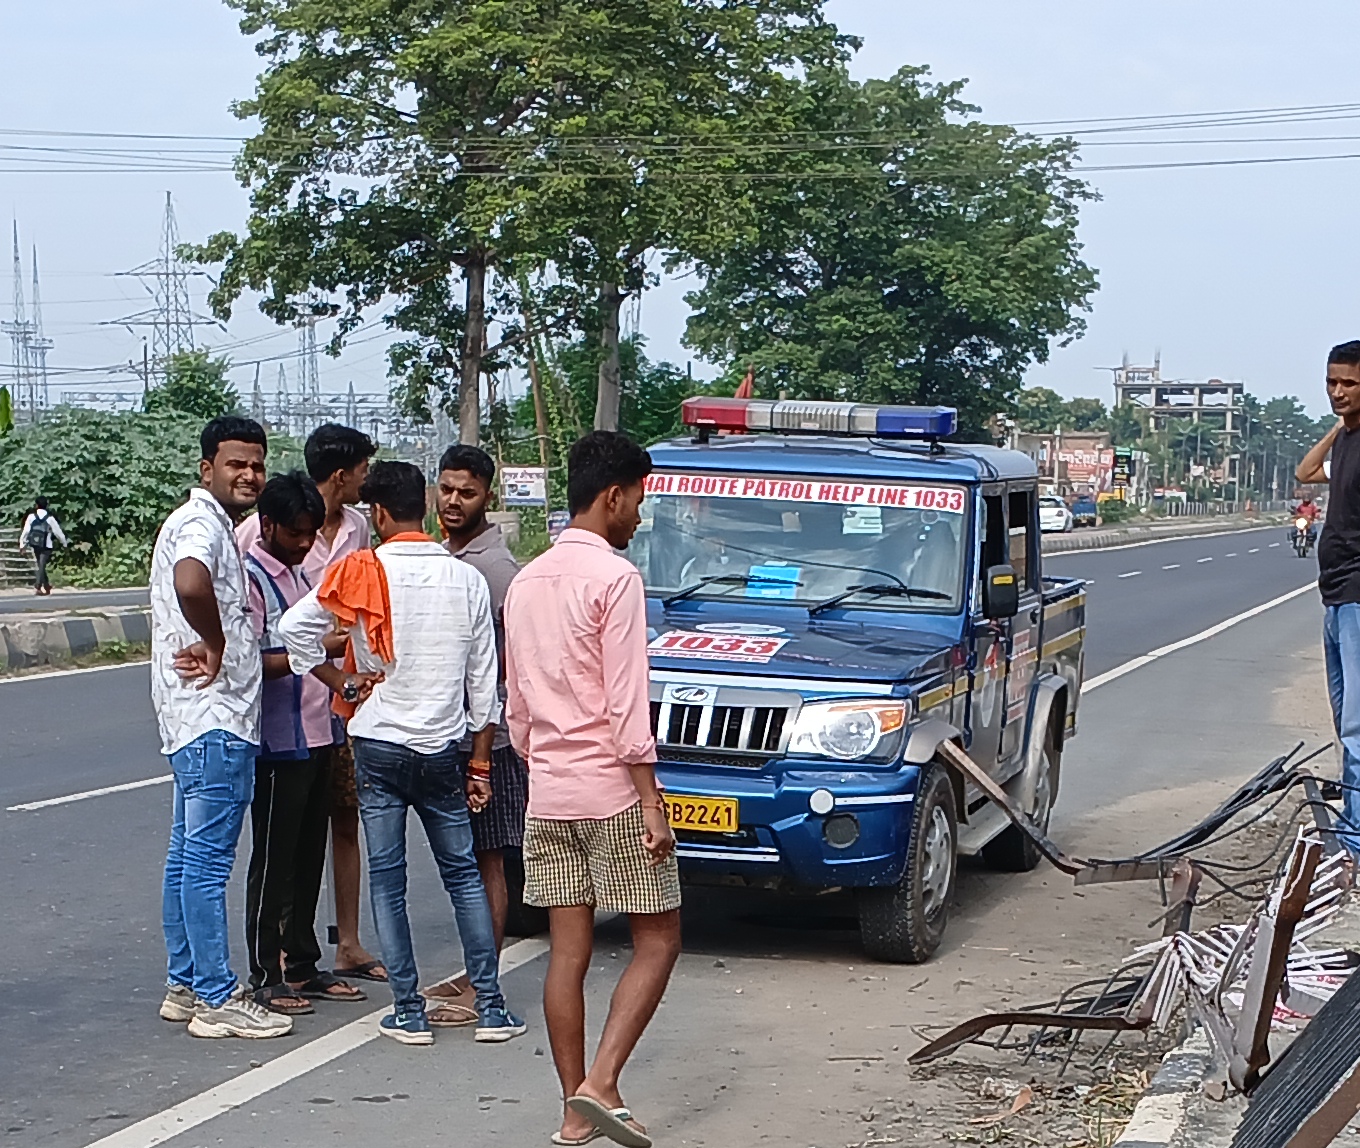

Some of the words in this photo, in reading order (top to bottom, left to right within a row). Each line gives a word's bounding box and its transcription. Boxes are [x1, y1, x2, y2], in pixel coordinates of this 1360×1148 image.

[643, 475, 674, 493] HAI
[677, 477, 739, 495] ROUTE
[742, 478, 813, 500] PATROL
[818, 484, 864, 503] HELP
[867, 487, 909, 506] LINE
[914, 489, 963, 511] 1033
[661, 635, 779, 654] 1033
